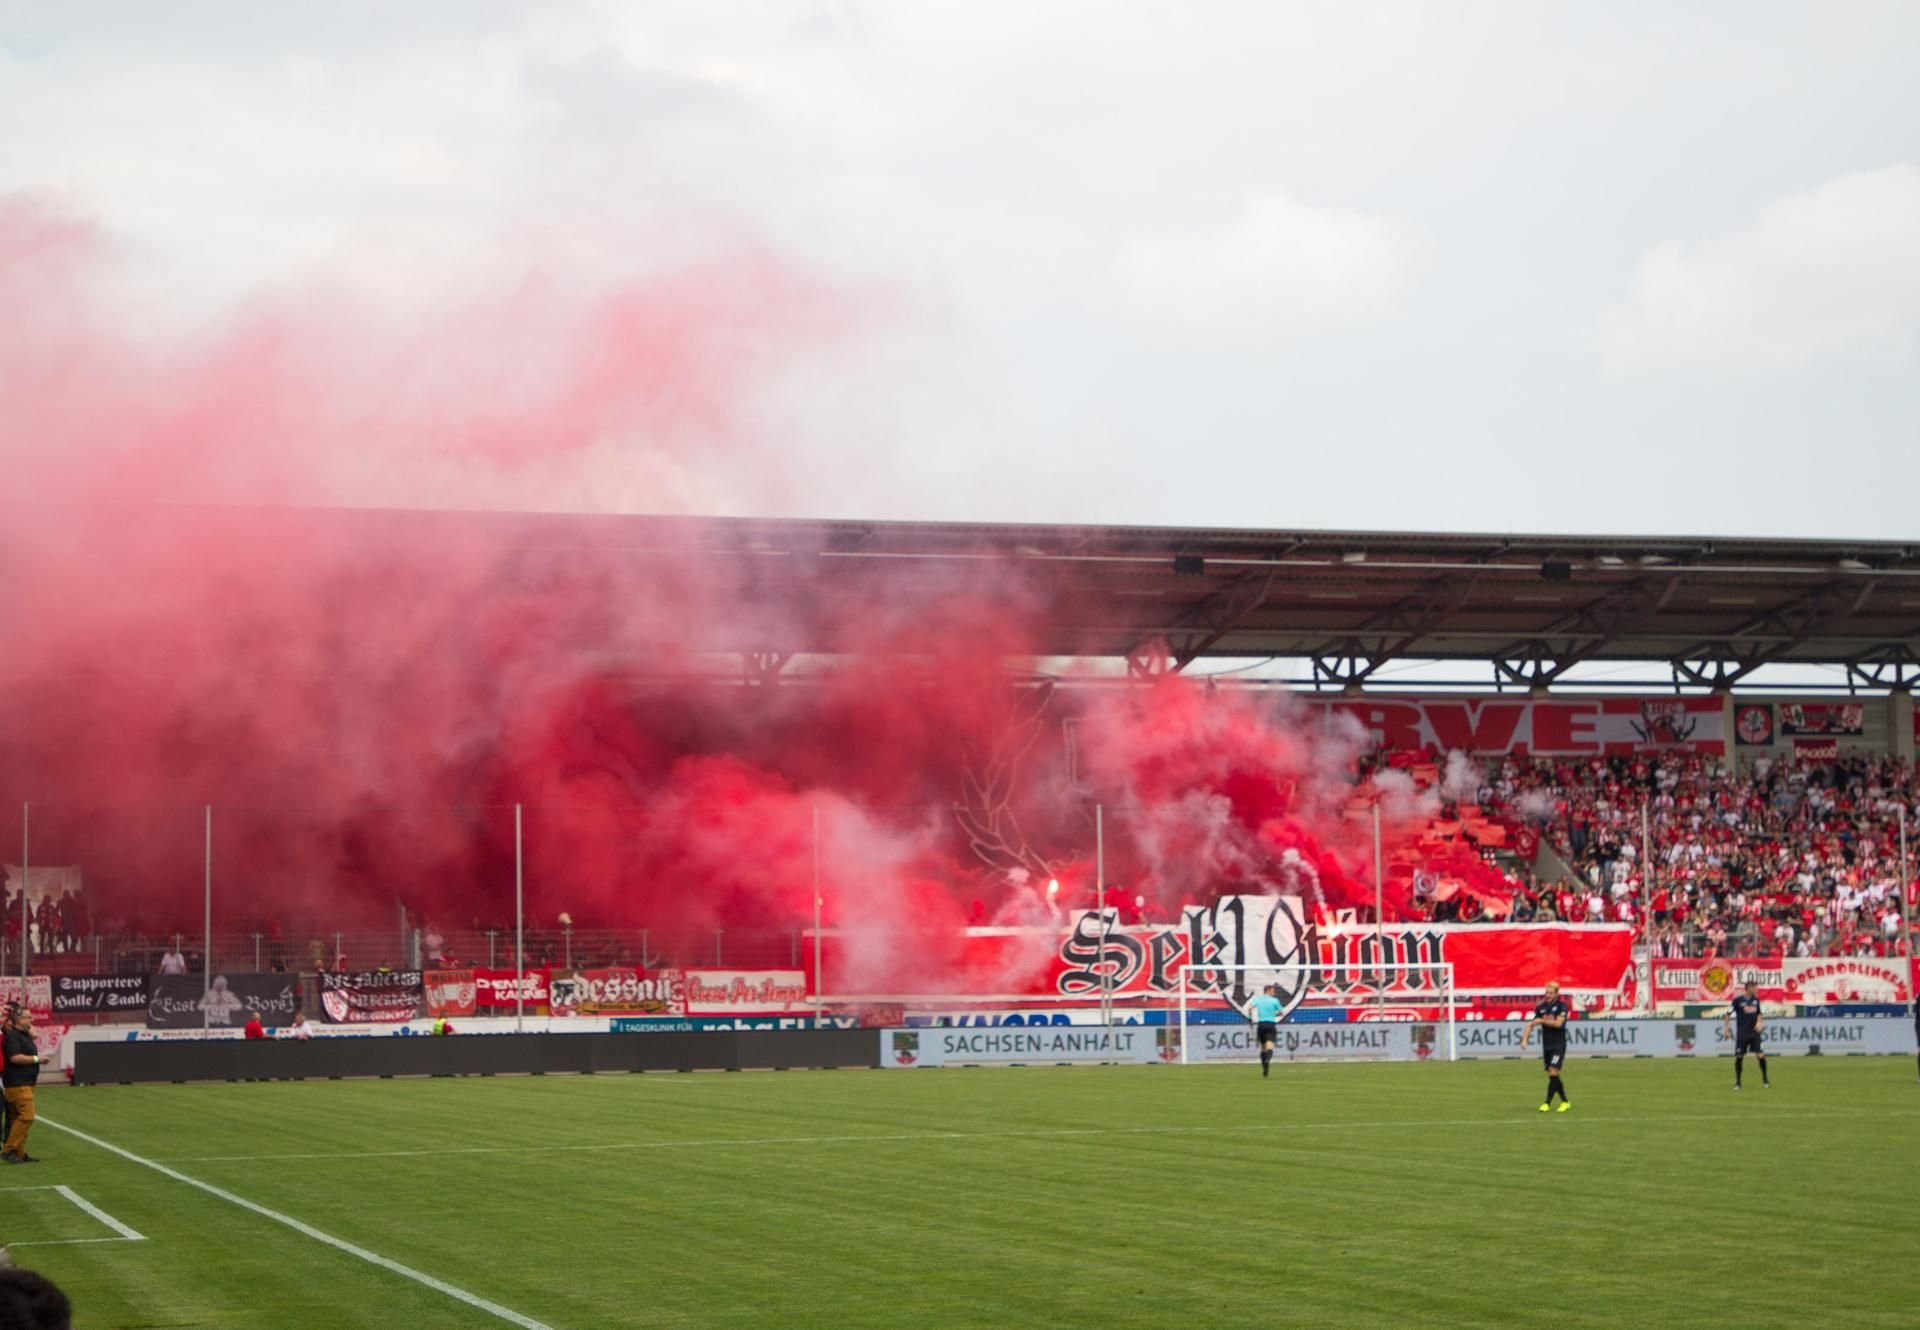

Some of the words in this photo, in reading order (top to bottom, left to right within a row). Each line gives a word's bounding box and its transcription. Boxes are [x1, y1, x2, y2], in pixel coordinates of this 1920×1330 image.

[60, 977, 143, 991] Supporters
[54, 994, 94, 1008] Halle
[106, 993, 147, 1006] Saale
[943, 1033, 1135, 1054] SACHSEN-ANHALT
[1205, 1029, 1389, 1049] SACHEN-ANHALT
